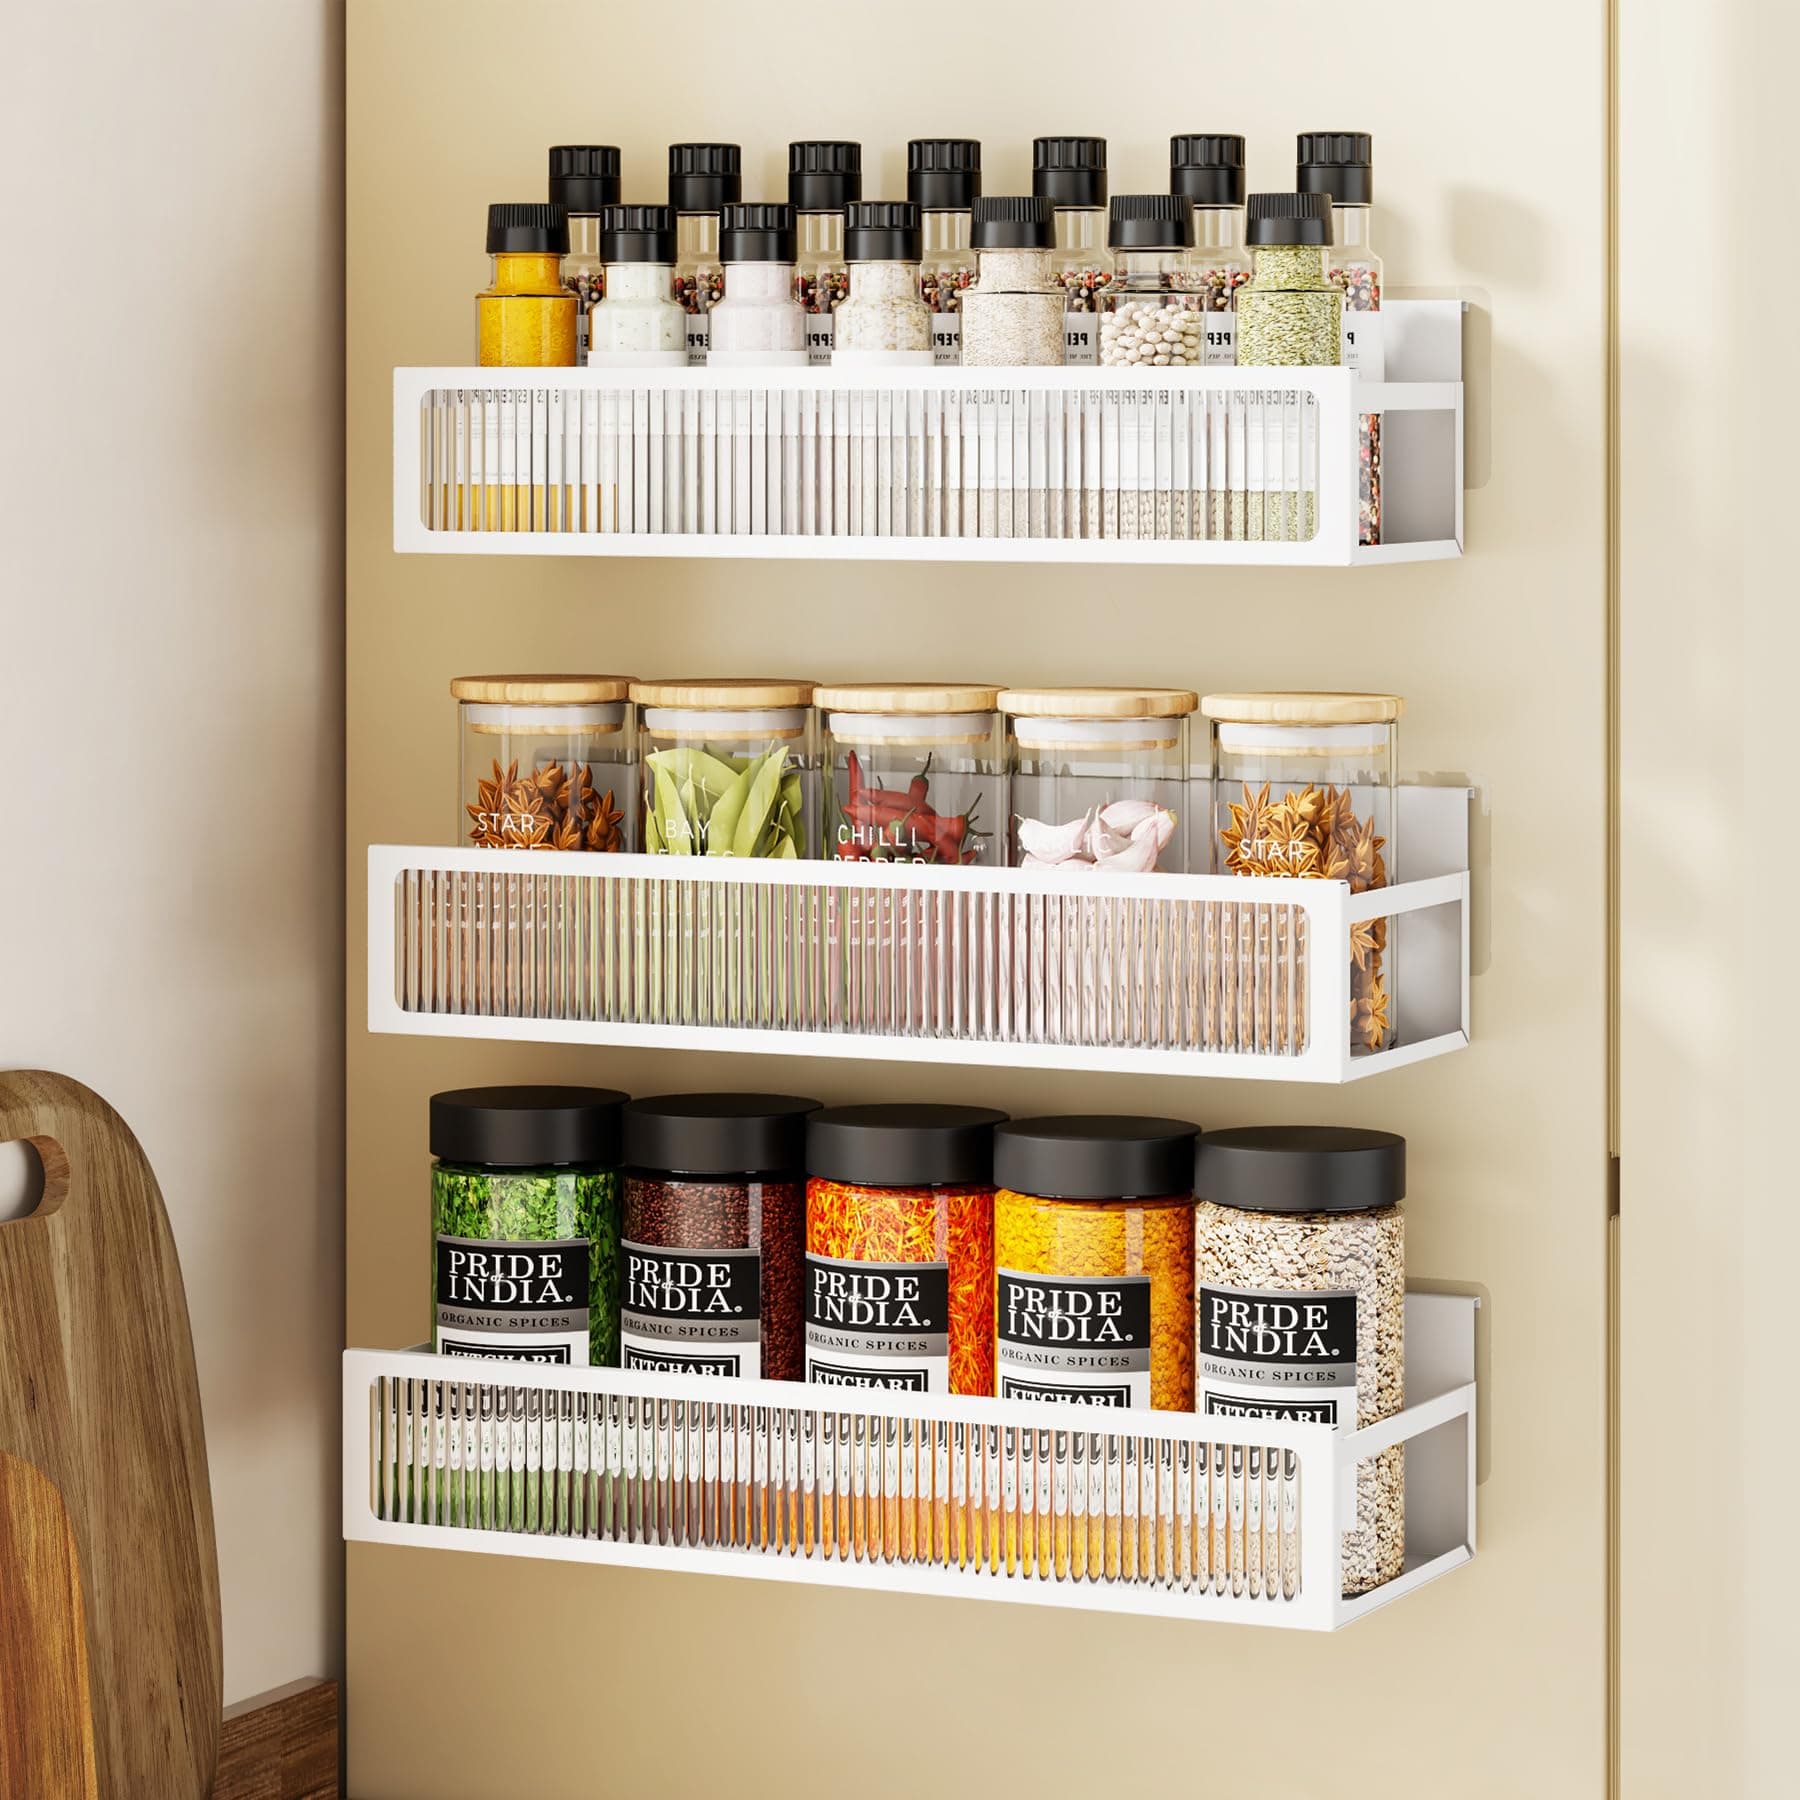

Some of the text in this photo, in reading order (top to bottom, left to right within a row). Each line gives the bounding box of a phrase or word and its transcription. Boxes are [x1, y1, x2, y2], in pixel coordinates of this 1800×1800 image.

[478, 812, 535, 833] STAR
[665, 819, 711, 839] BAY
[838, 824, 916, 847] CHILLI
[1239, 839, 1304, 861] STAR
[449, 1250, 563, 1279] PRIDE
[629, 1256, 732, 1288] PRIDE
[814, 1268, 920, 1301] PRIDE
[1007, 1283, 1122, 1316] PRIDE
[441, 1311, 570, 1328] ORGANIC SPICES
[1211, 1297, 1328, 1331] PRIDE
[623, 1317, 739, 1337] ORGANIC SPICES
[808, 1330, 928, 1351] ORGANIC SPICES
[1001, 1347, 1130, 1367] ORGANIC SPICES
[1204, 1362, 1337, 1382] ORGANIC SPICES
